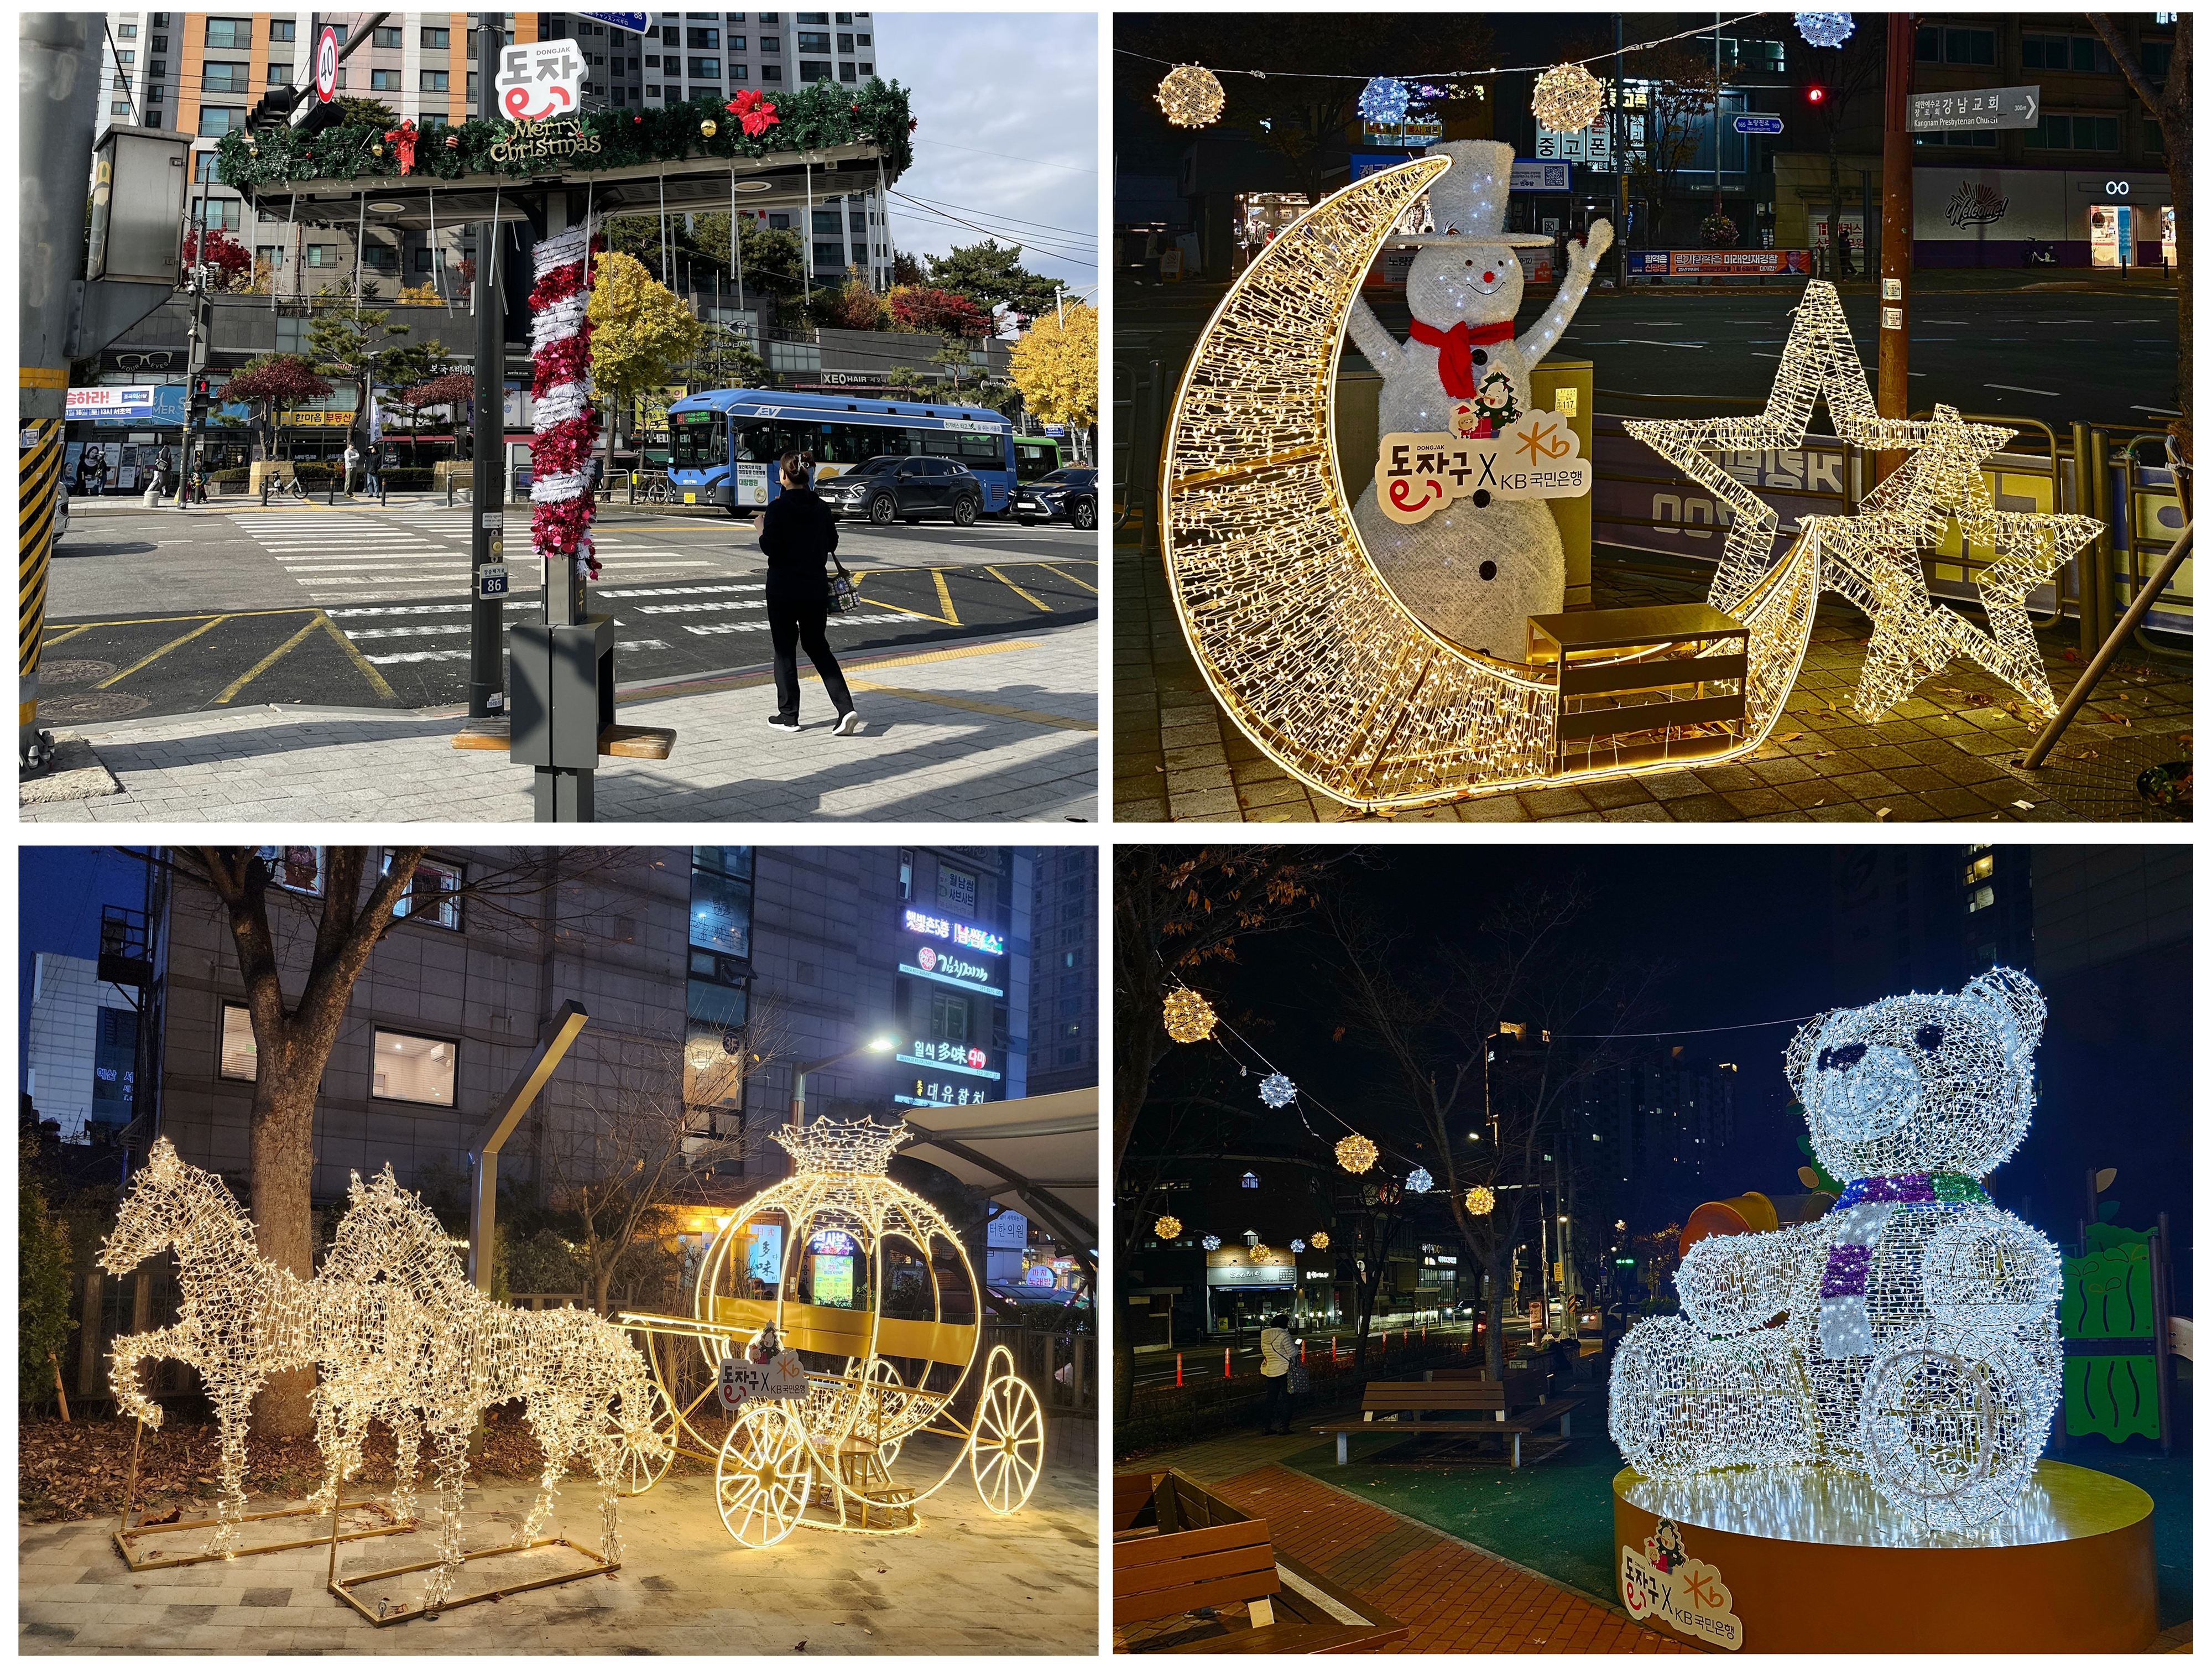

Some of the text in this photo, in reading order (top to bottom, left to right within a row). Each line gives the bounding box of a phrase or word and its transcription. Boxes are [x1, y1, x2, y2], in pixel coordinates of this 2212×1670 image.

[536, 46, 571, 56] DONGJAK
[321, 45, 333, 81] 40
[1914, 100, 1940, 110] 대한예수교
[1942, 95, 2000, 115] 강남교회
[512, 117, 580, 139] Merry
[1914, 119, 1939, 128] Kangnam
[1939, 117, 1975, 127] Presbyterian
[1408, 125, 1439, 135] 복사.제본
[490, 135, 602, 162] Christmas
[1538, 137, 1606, 157] 중고폰
[1944, 196, 2010, 227] Welcome!
[1645, 254, 1667, 264] 합격은
[1675, 254, 1778, 265] 단기합격은 미래인재경찰
[1645, 263, 1667, 273] 신광은
[121, 361, 169, 372] FOUR EYES
[823, 373, 846, 384] XEO
[1562, 400, 1574, 409] 117
[295, 413, 352, 423] 한마음 부동산
[760, 408, 778, 416] EV
[1477, 452, 1498, 487] X
[1501, 470, 1583, 490] KB 국민은행
[487, 579, 502, 592] 86
[949, 873, 974, 893] 월남쌈
[902, 965, 932, 977] KOREA RESTAURANT
[915, 1041, 985, 1068] 일식 多味 다미
[915, 1058, 933, 1066] RESTAURANT
[926, 1083, 985, 1105] 대유참치
[989, 1222, 1024, 1239] 터한의원
[1053, 1261, 1071, 1269] KFC
[1029, 1278, 1051, 1286] 노래방
[760, 1372, 769, 1392] X
[770, 1385, 805, 1394] KB 국민은행
[1661, 1583, 1673, 1615] X
[1674, 1607, 1735, 1641] KB 국민은행
